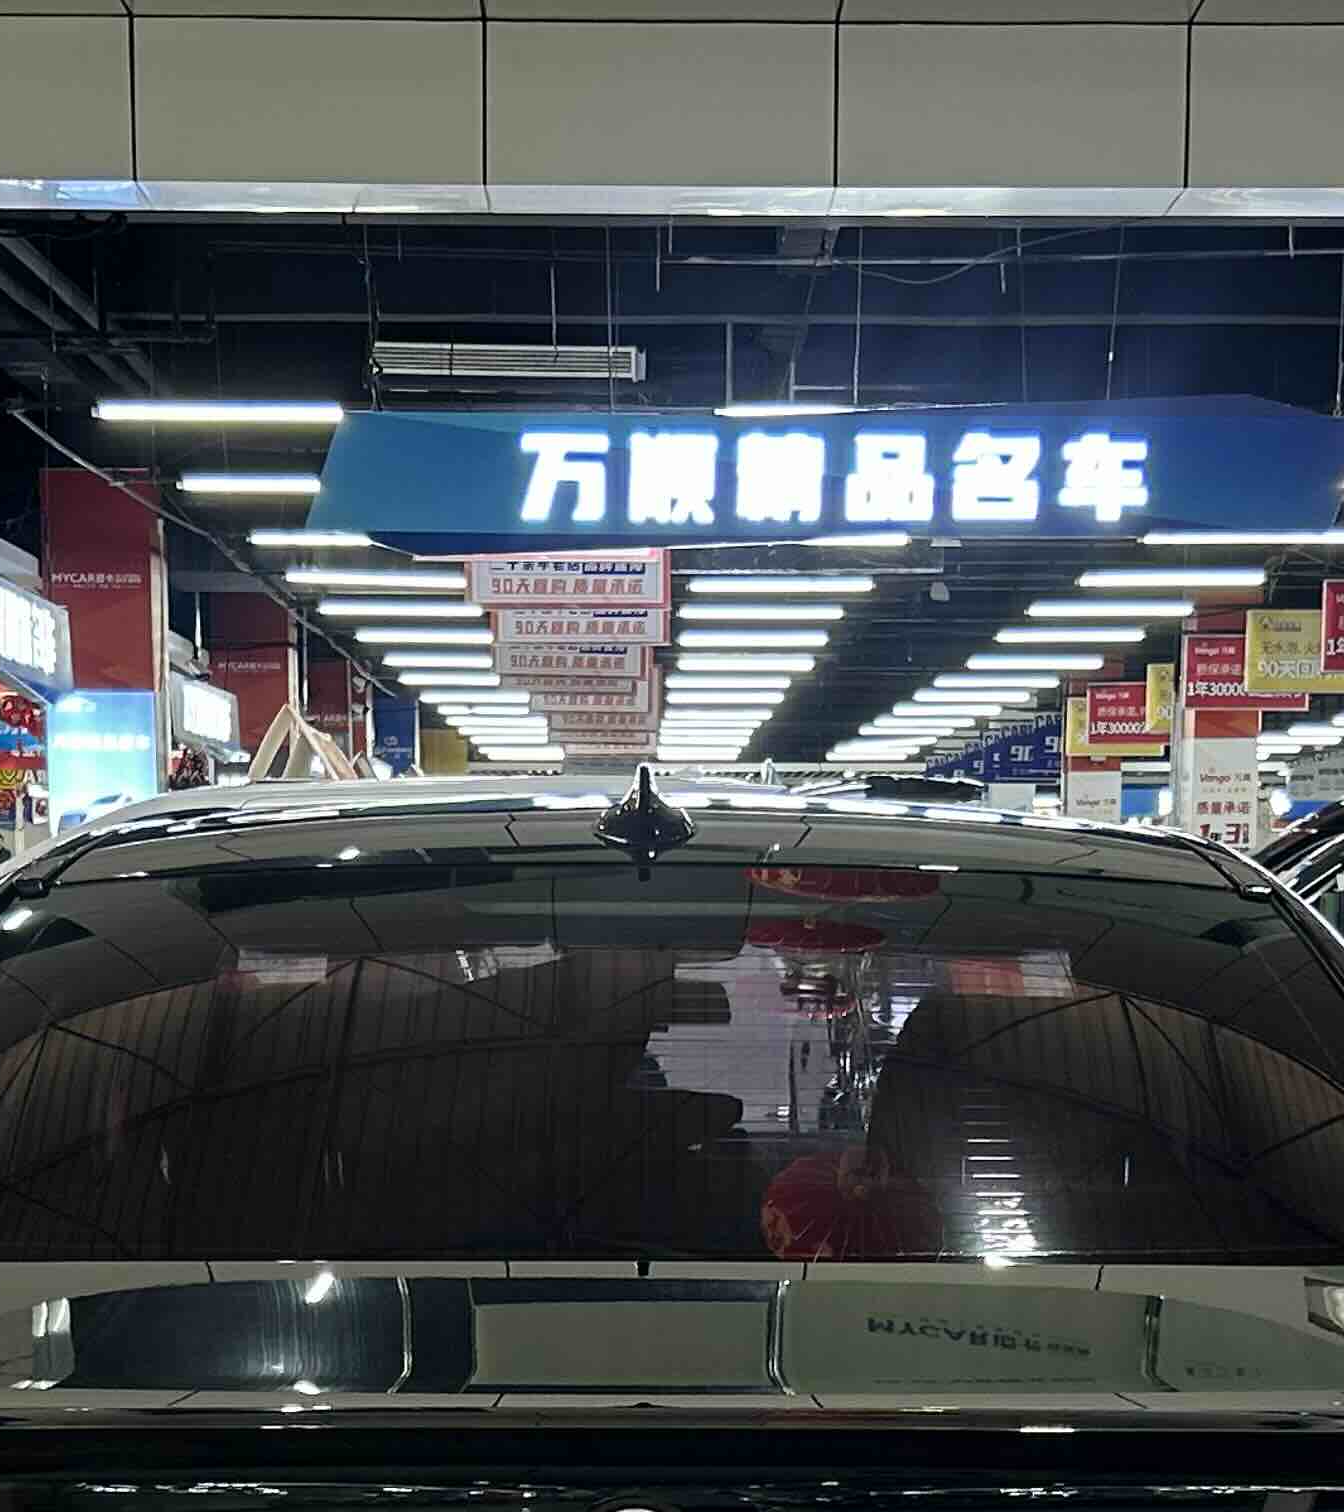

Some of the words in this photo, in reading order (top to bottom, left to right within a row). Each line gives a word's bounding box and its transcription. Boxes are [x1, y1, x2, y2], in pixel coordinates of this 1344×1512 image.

[519, 429, 1152, 524] 万顺精品名车
